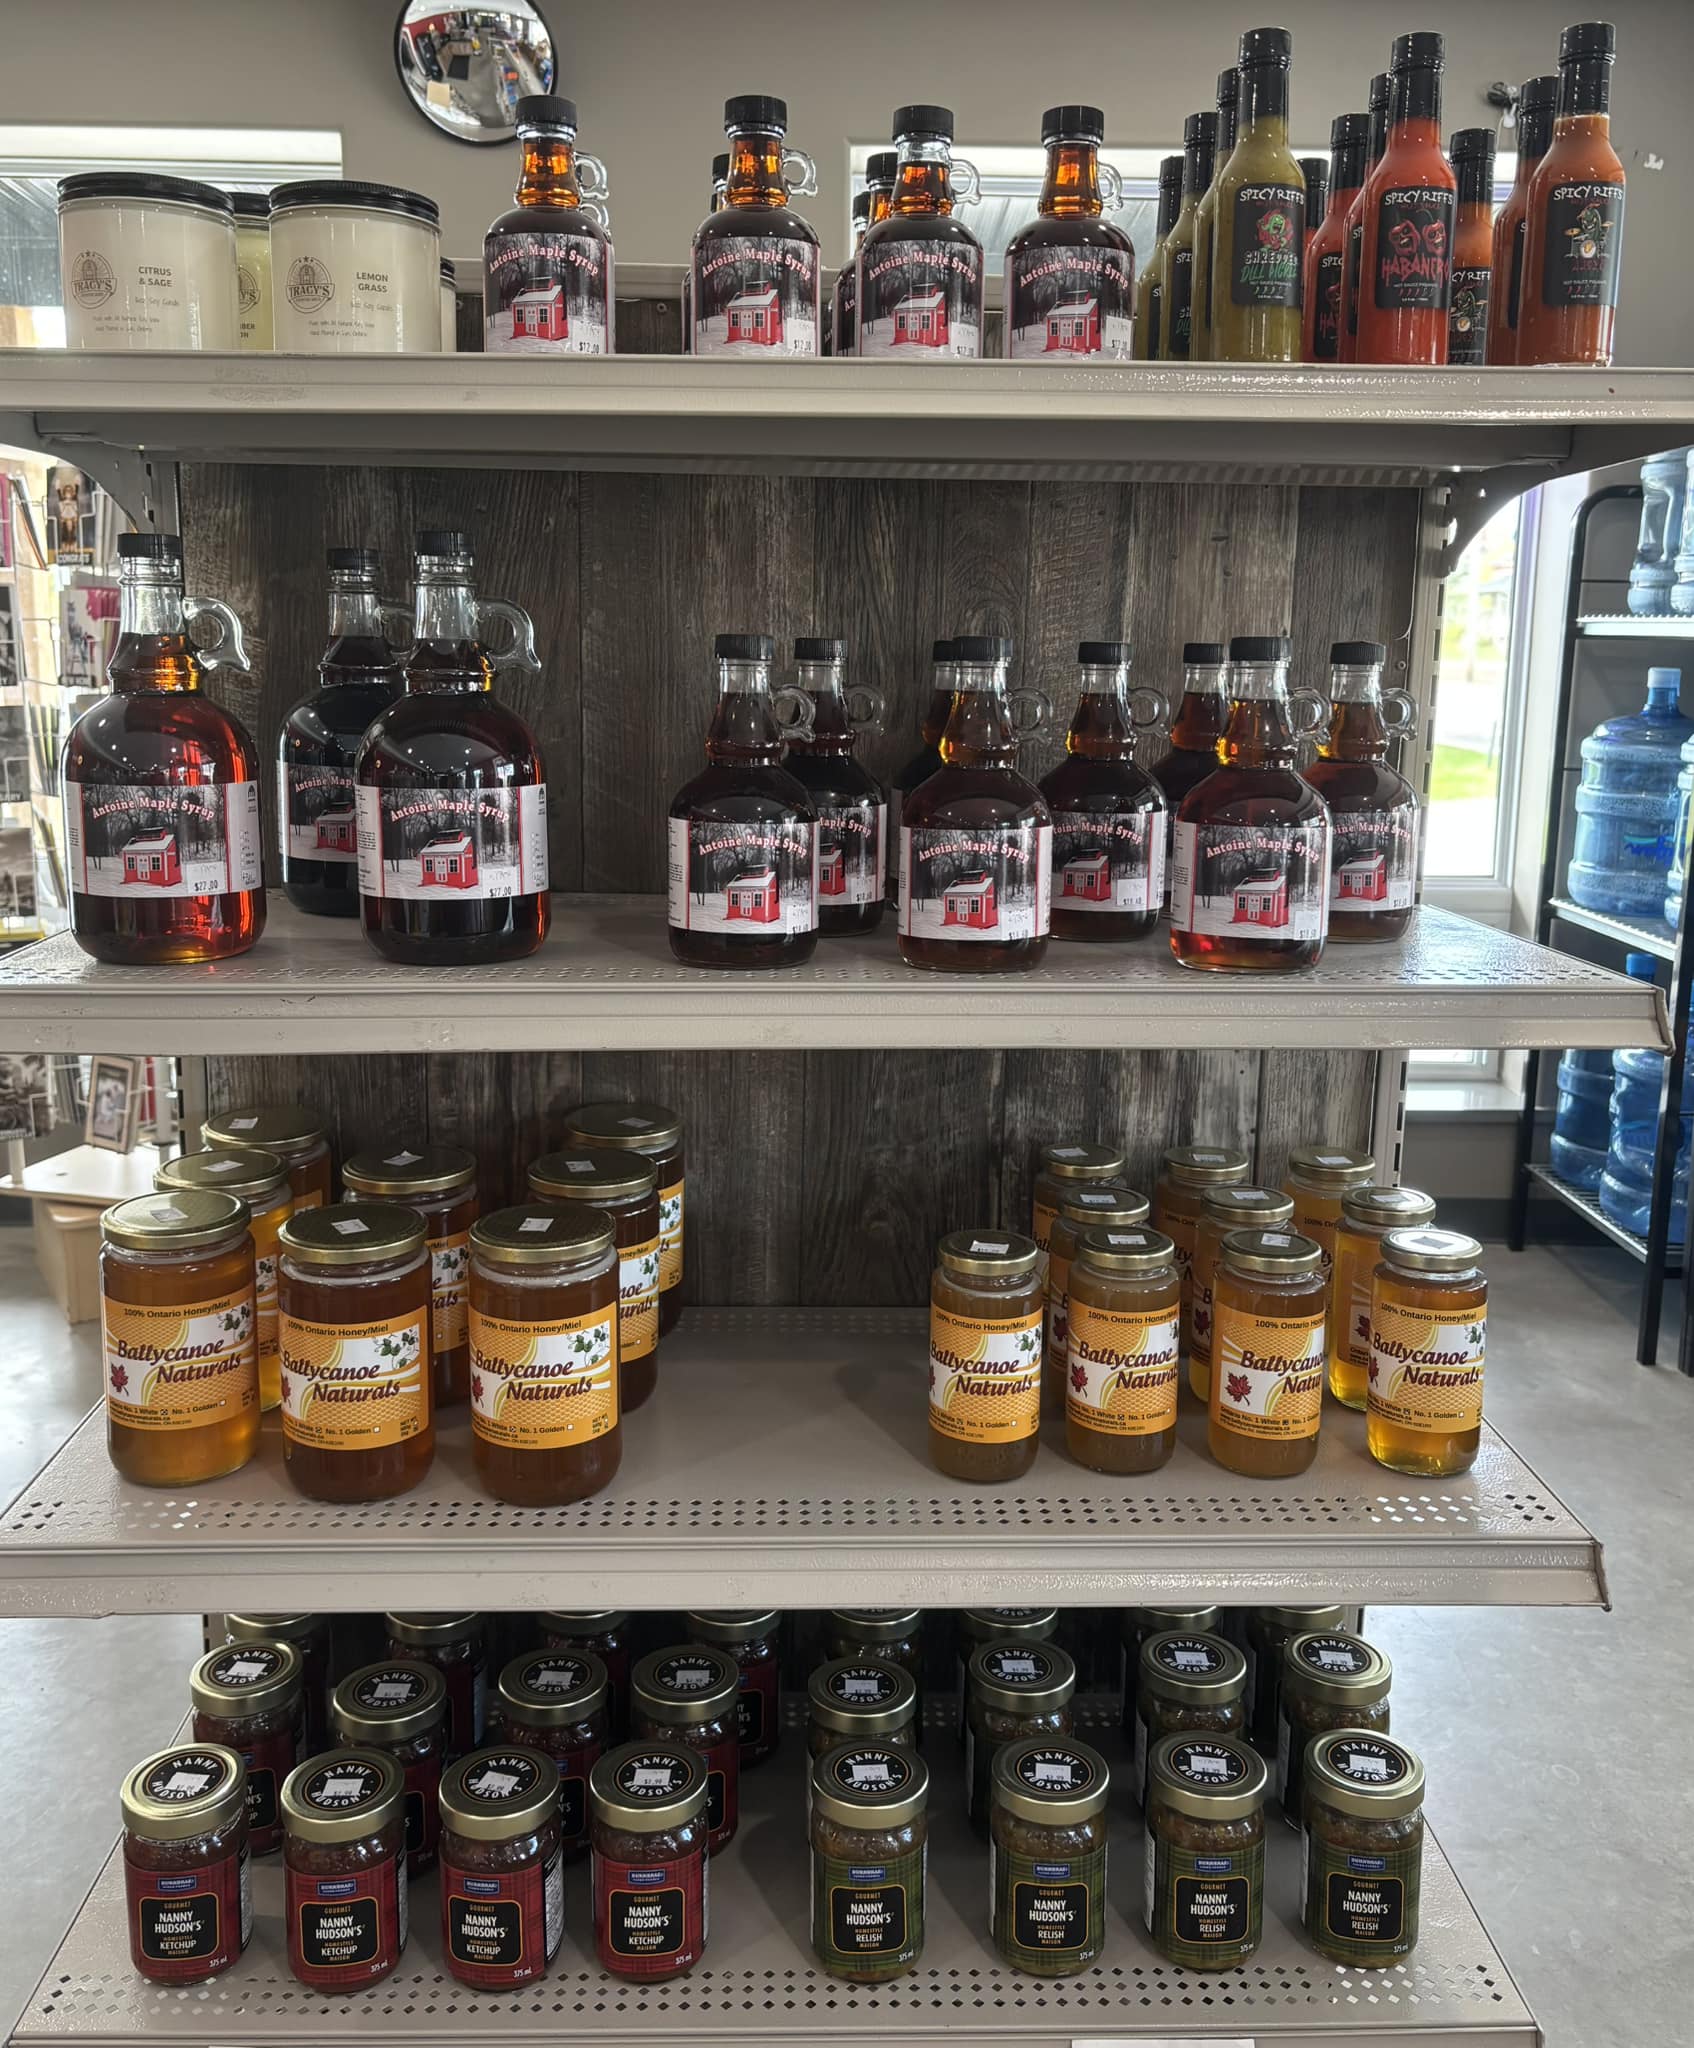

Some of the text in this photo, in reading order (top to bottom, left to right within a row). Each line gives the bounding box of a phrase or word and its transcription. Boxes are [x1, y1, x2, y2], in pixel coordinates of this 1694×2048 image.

[1240, 188, 1304, 205] SPICY RIFFS
[1385, 190, 1454, 206] SPICY RIFFS
[1554, 185, 1623, 200] SPICY RIFFS
[489, 243, 599, 276] Antoine Maple Syrup
[702, 248, 812, 280] Antoine Maple Syrup
[138, 266, 172, 276] CITRUS
[869, 251, 976, 284] Antoine Maple Syrup
[1020, 257, 1129, 290] Antoine Maple Syrup
[1382, 253, 1450, 288] HABANERO
[148, 278, 173, 287] SAGE
[356, 272, 388, 282] LEMON
[74, 279, 113, 293] TRACY'S
[289, 285, 330, 298] TRACY'S
[358, 283, 388, 293] GRASS
[92, 797, 215, 820] Antoine Maple Syrup
[390, 799, 510, 824] Antoine Maple Syrup
[849, 819, 872, 838] Syrup
[1081, 821, 1143, 845] Maple Syrup
[1358, 821, 1390, 833] Maple
[699, 835, 807, 858] Antoine Maple Syrup
[918, 840, 1030, 864] Antoine Maple Syrup
[1205, 837, 1320, 864] Antoine Maple Syrup
[147, 1310, 181, 1318] Ontario
[1088, 1311, 1142, 1324] 100% Ontario
[1400, 1309, 1432, 1321] Ontario
[500, 1324, 530, 1333] Ontario
[952, 1318, 981, 1330] Ontario
[1255, 1320, 1278, 1329] 100%
[305, 1326, 336, 1336] Ontario
[156, 1353, 241, 1384] Naturals
[1402, 1365, 1480, 1387] Naturals
[313, 1380, 400, 1403] Naturals
[506, 1376, 592, 1401] Naturals
[955, 1374, 1032, 1396] Naturals
[192, 1402, 218, 1412] Golden
[539, 1425, 565, 1434] Golden
[1167, 1640, 1210, 1652] NANNY
[1310, 1639, 1353, 1651] NANNY
[232, 1650, 274, 1661] NANNY
[995, 1650, 1036, 1660] NANNY
[538, 1659, 581, 1670] NANNY
[669, 1657, 712, 1668] NANNY
[371, 1672, 416, 1683] NANNY
[841, 1669, 884, 1680] NANNY
[1184, 1744, 1232, 1758] NANNY
[1340, 1742, 1388, 1756] NANNY
[172, 1755, 218, 1770] NANNY
[488, 1758, 532, 1773] NANNY
[631, 1756, 678, 1770] NANNY
[845, 1752, 891, 1766] NANNY
[1033, 1752, 1081, 1766] NANNY
[323, 1765, 372, 1778] NANNY
[1195, 1894, 1228, 1905] NANNY
[1348, 1890, 1382, 1902] NANNY
[628, 1905, 662, 1917] NANNY
[850, 1902, 884, 1914] NANNY
[1034, 1899, 1067, 1910] NANNY
[1190, 1903, 1235, 1916] HUDSON'S
[1343, 1900, 1389, 1914] HUDSON'S
[159, 1911, 194, 1922] NANNY
[319, 1915, 354, 1928] NANNY
[465, 1913, 498, 1926] NANNY
[623, 1915, 670, 1929] HUDSON'S
[846, 1912, 892, 1925] HUDSON'S
[1029, 1909, 1074, 1922] HUDSON'S
[154, 1920, 202, 1934] HUDSON'S
[315, 1925, 363, 1940] HUDSON'S
[461, 1924, 506, 1939] HUDSON'S
[1200, 1923, 1226, 1932] RELISH
[1352, 1921, 1379, 1931] RELISH
[628, 1936, 665, 1945] KETCHUP
[856, 1933, 882, 1942] RELISH
[1038, 1930, 1064, 1939] RELISH
[159, 1939, 197, 1950] KETCHUP
[321, 1945, 358, 1957] KETCHUP
[466, 1944, 501, 1955] KETCHUP
